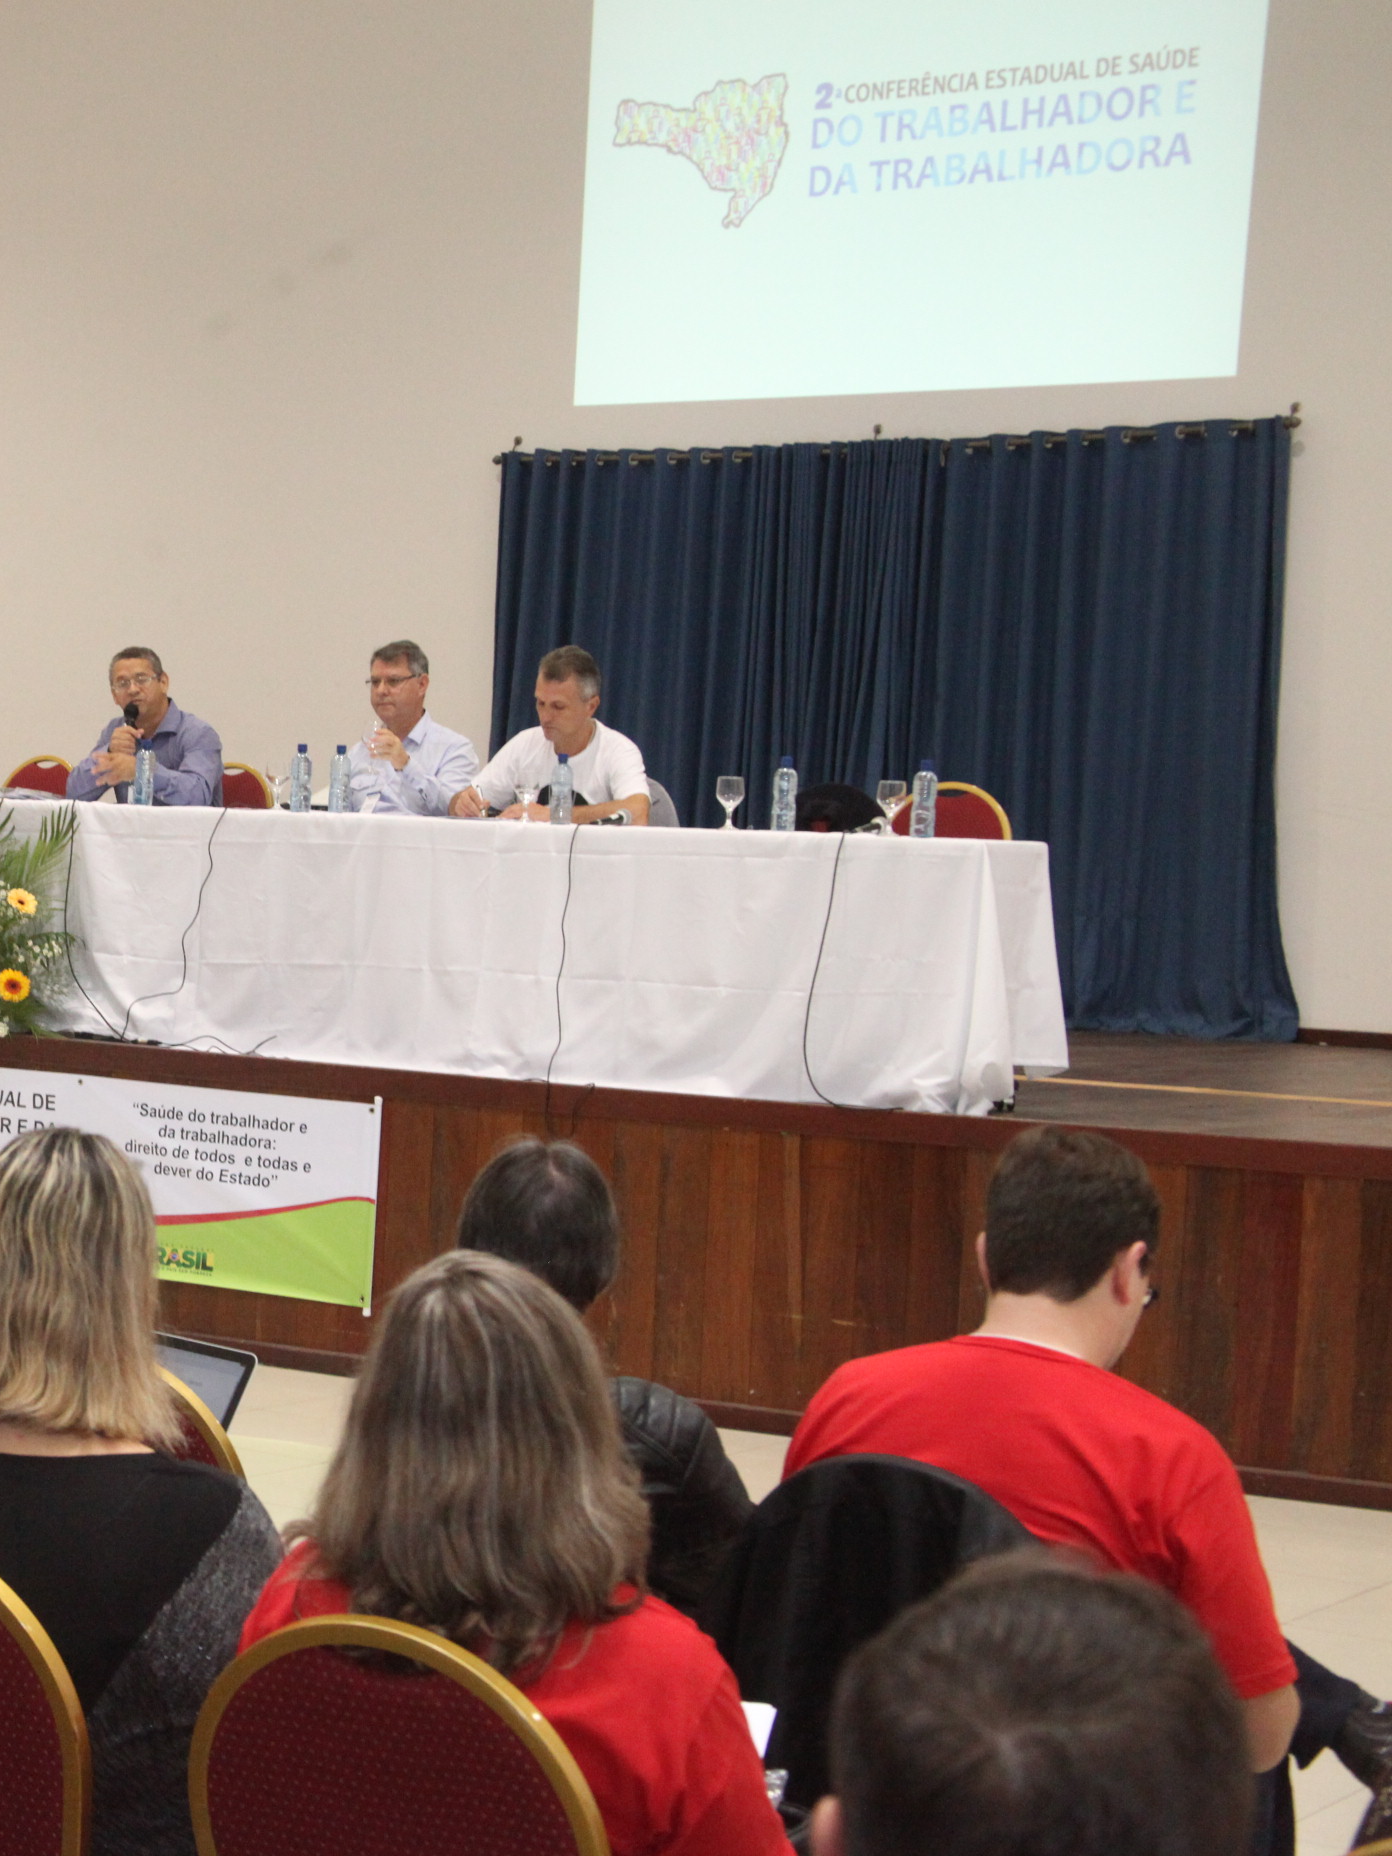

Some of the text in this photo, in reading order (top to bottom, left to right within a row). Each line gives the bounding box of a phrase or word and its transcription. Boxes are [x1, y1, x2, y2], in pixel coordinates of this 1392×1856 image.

[844, 71, 979, 103] CONFERÊNCIA
[985, 60, 1090, 89] ESTADUAL
[1095, 55, 1122, 78] DE
[1128, 45, 1200, 75] SAÚDE
[811, 79, 1198, 149] DO TRABALHADOR E
[808, 132, 1192, 197] DA TRABALHADORA
[32, 1093, 56, 1111] DE
[188, 1109, 206, 1123] do
[210, 1111, 295, 1132] trabalhador
[299, 1122, 308, 1134] e
[158, 1125, 276, 1150] da trabalhadora:
[125, 1139, 312, 1173] direito de todos e todas e
[154, 1162, 192, 1178] dever
[196, 1167, 214, 1182] do
